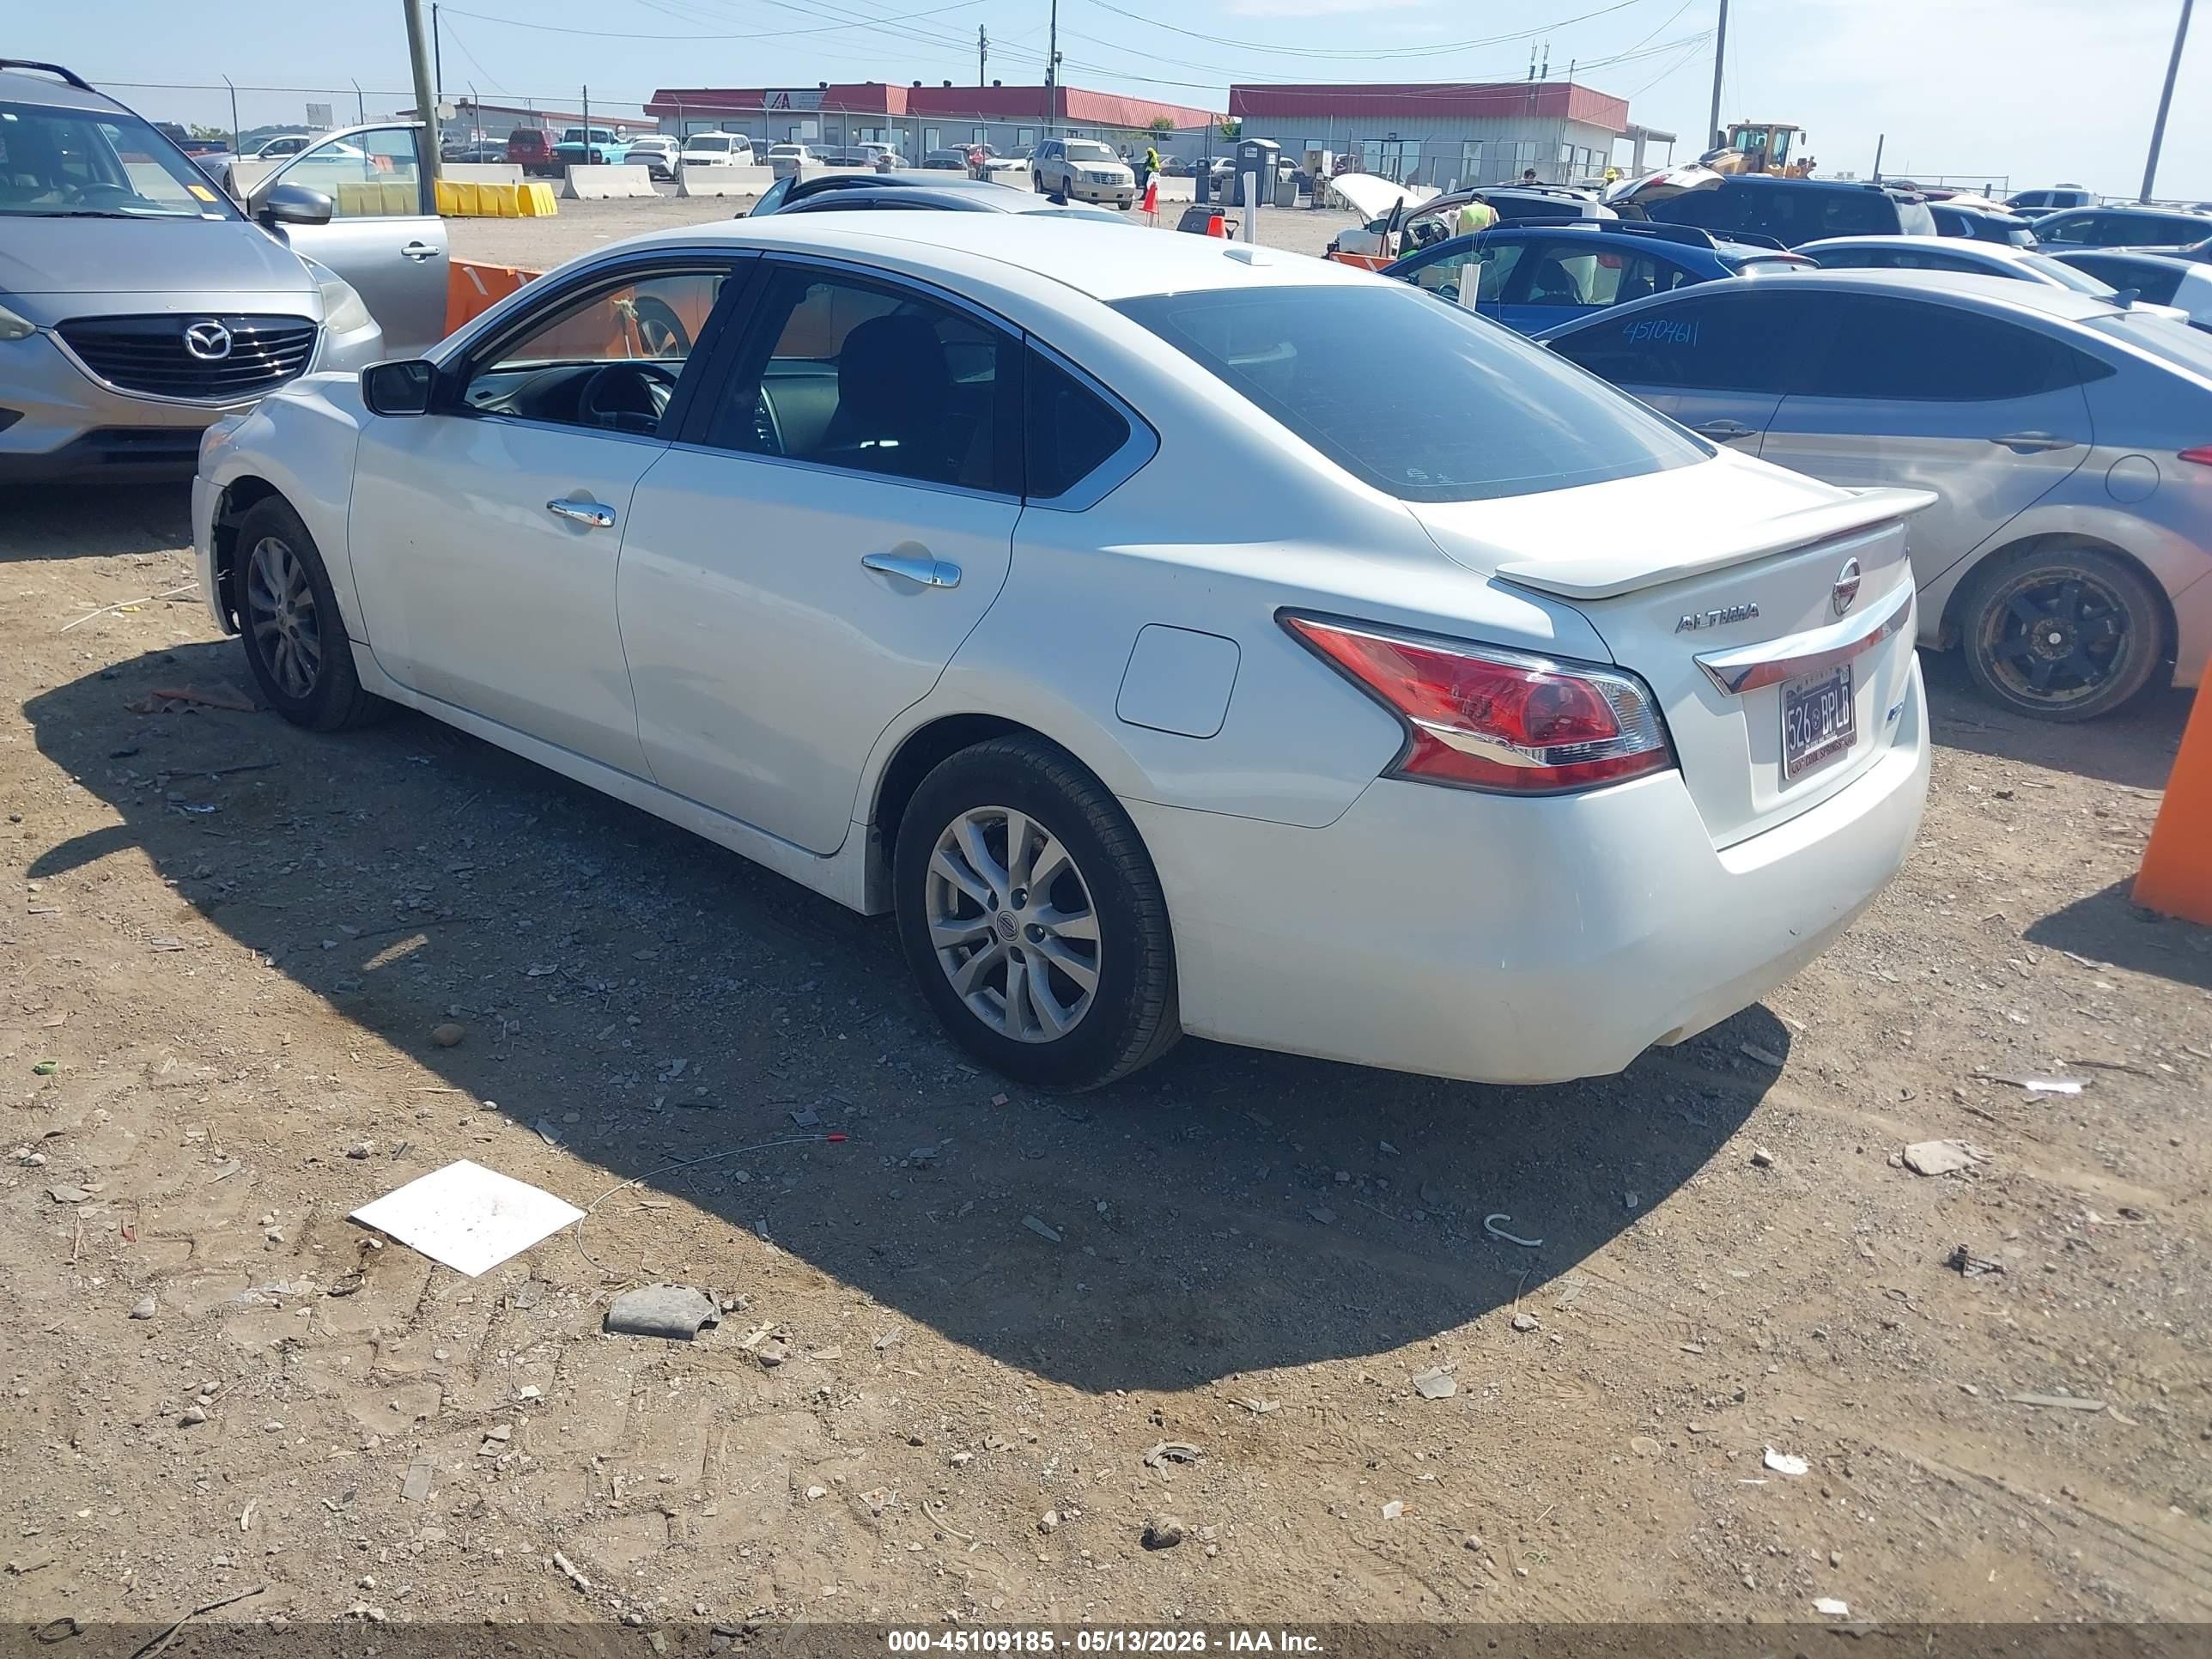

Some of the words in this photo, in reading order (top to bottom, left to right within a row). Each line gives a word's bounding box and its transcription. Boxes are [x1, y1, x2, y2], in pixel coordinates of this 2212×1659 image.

[1622, 319, 1698, 347] 45104611
[1674, 602, 1759, 634] ALTIMA
[1787, 702, 1811, 751] 526
[1820, 685, 1850, 736] BPLB
[1805, 751, 1820, 769] COOL
[1820, 739, 1841, 759] SPRINGS
